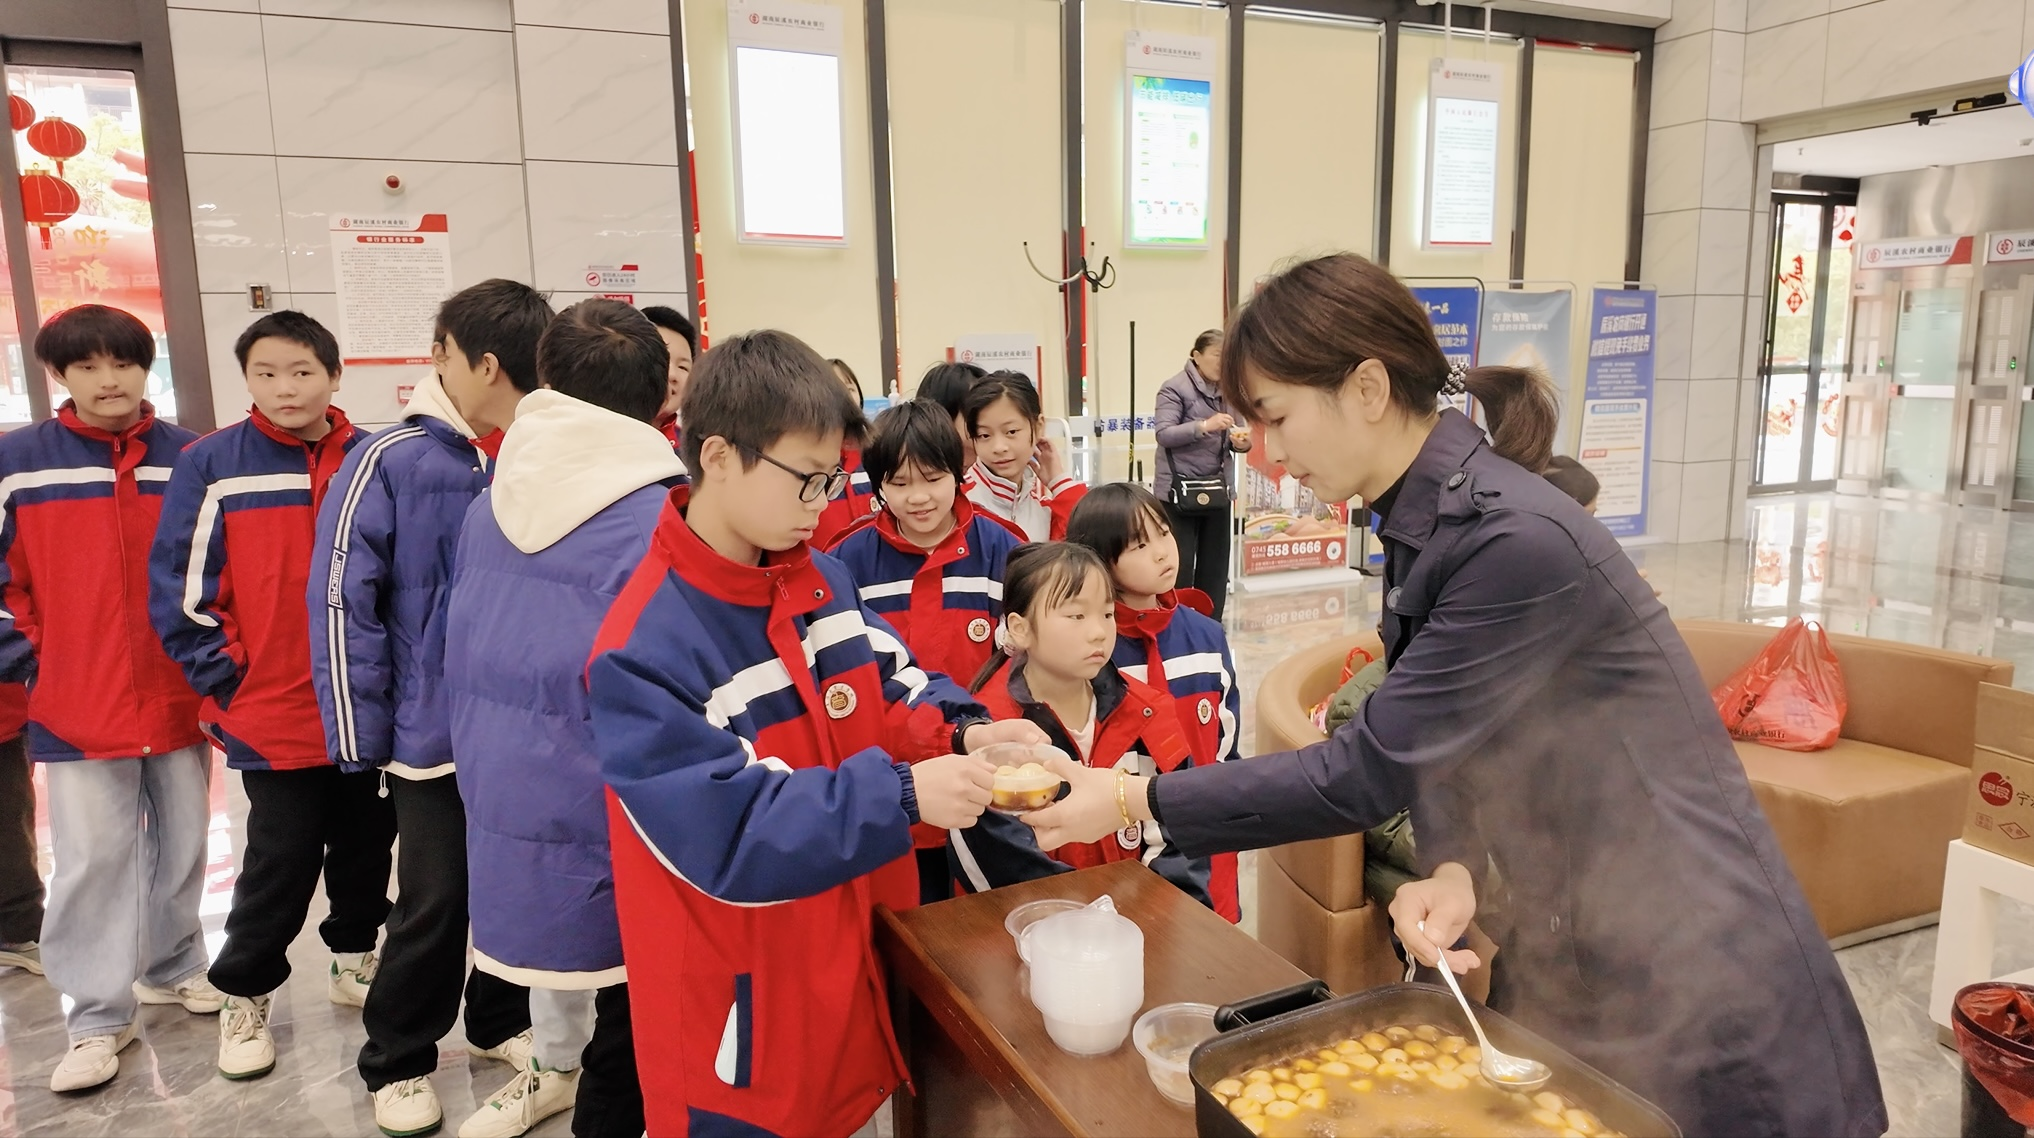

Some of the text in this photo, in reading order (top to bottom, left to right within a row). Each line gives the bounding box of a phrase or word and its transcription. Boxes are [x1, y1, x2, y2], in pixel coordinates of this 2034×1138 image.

[1884, 244, 1950, 257] 辰溪农村商业银行
[1267, 543, 1289, 557] 558
[1291, 541, 1321, 555] 6666
